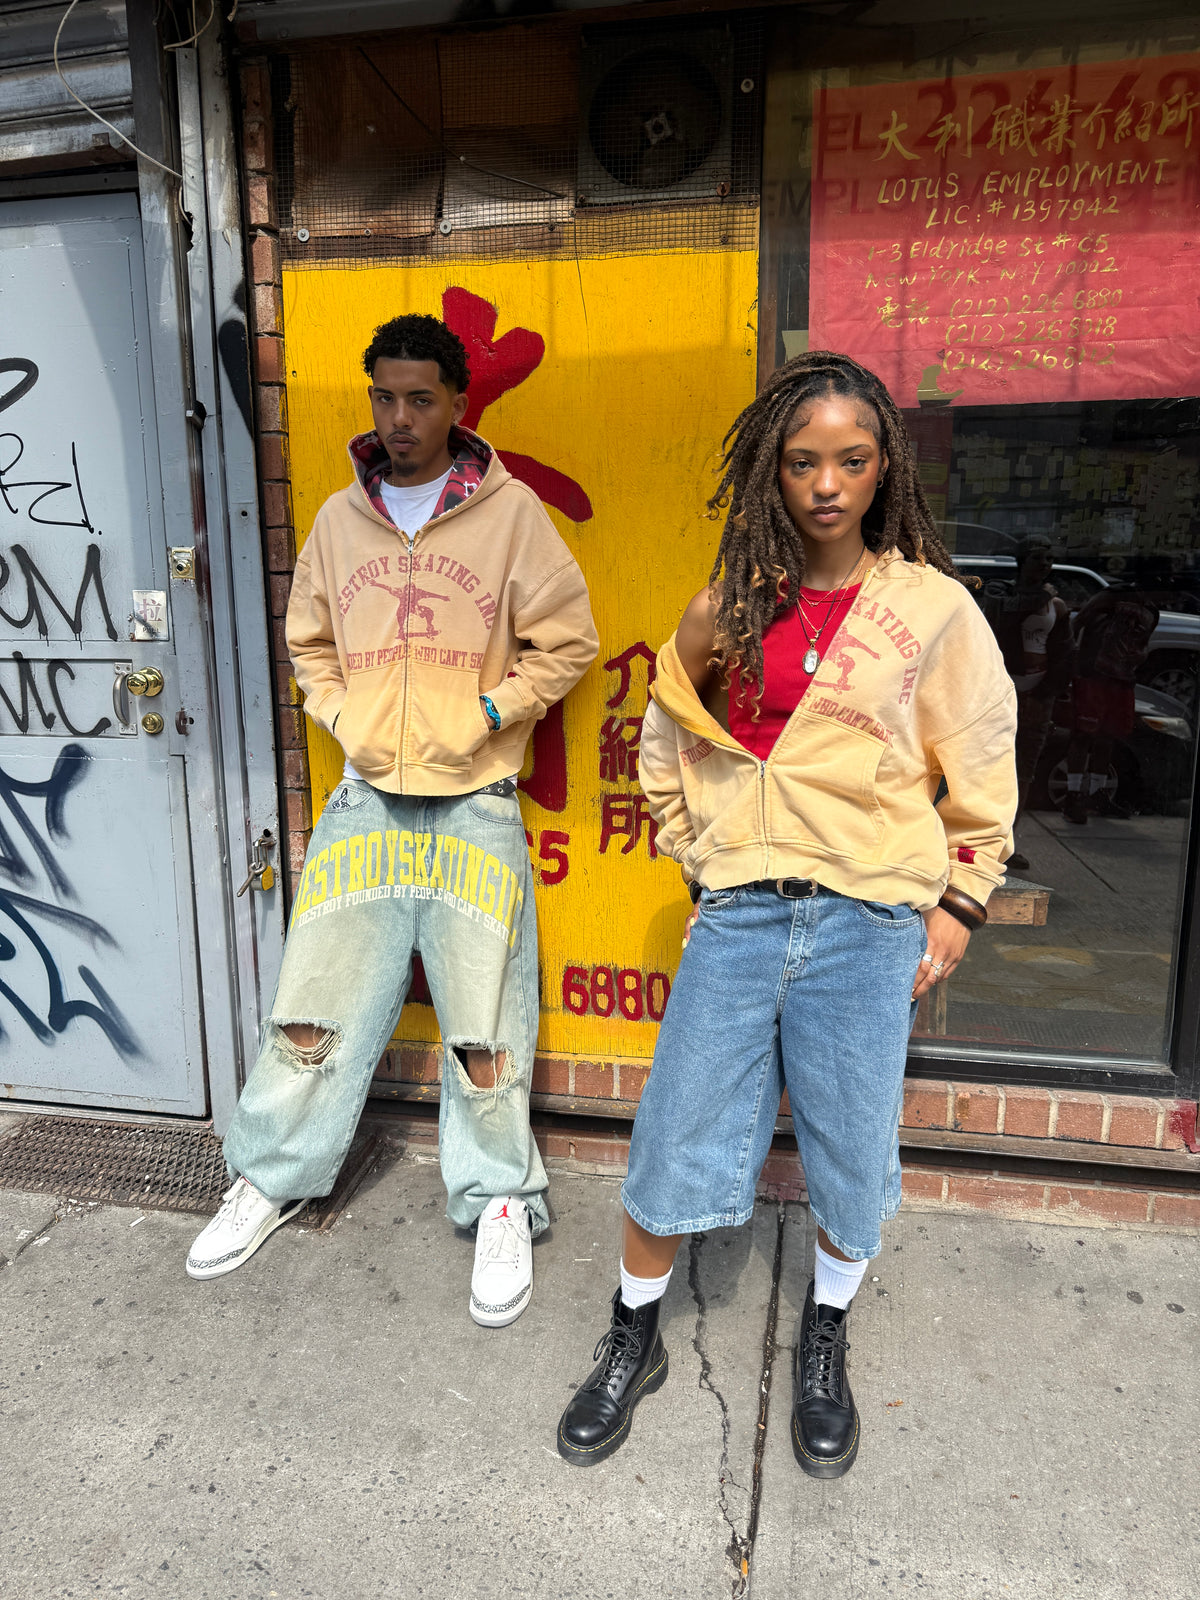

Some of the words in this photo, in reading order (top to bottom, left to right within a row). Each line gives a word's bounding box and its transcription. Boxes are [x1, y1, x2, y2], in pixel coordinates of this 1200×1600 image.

[872, 92, 1200, 162] 大利職業介紹所
[877, 172, 960, 205] LOTUS
[982, 158, 1171, 198] EMPLOYMENT
[868, 243, 902, 262] 1-3
[909, 232, 1007, 264] Eldridge
[139, 598, 162, 622] 拉
[337, 555, 391, 623] ESTROY
[397, 553, 482, 595] SKATING
[851, 593, 922, 660] KATING
[364, 650, 376, 667] BY
[377, 644, 411, 666] PEOPLE
[415, 645, 437, 663] WHO
[439, 648, 468, 668] CAN'T
[469, 652, 484, 669] SK
[297, 894, 343, 929] DESTROY
[345, 885, 391, 908] FOUNDED
[392, 884, 407, 899] BY
[410, 884, 443, 901] PEOPLE
[457, 897, 483, 922] CAN'T
[562, 964, 671, 1022] 6880
